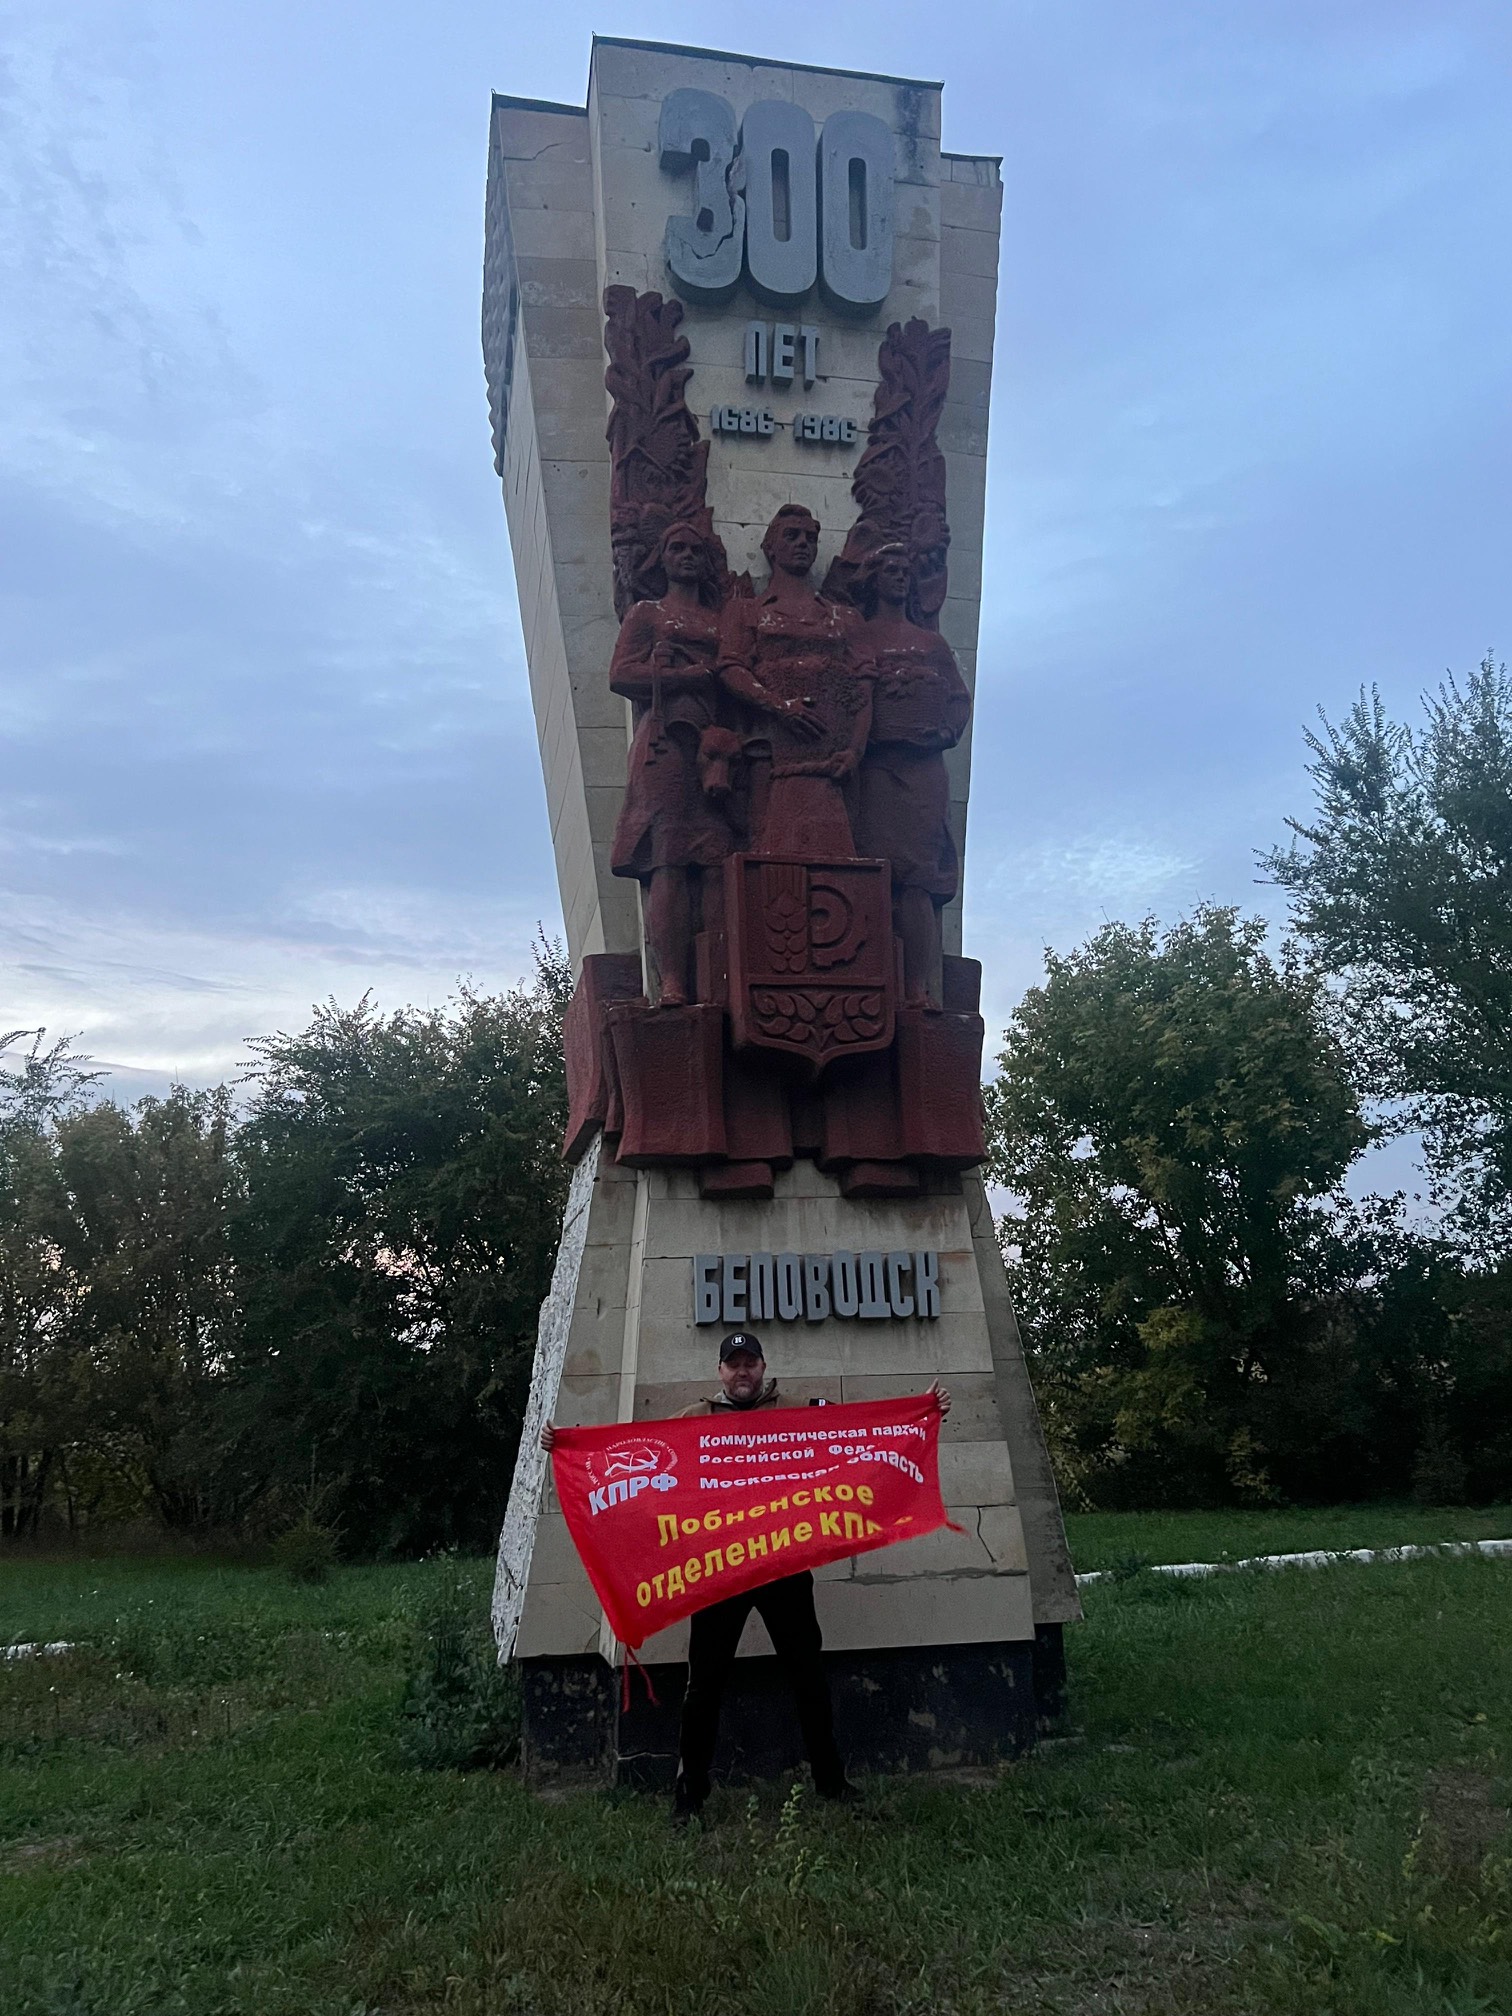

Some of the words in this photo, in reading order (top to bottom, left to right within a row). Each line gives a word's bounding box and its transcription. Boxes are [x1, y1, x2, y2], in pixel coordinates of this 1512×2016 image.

[658, 87, 896, 307] 300
[711, 404, 775, 436] 1686
[794, 412, 858, 444] 1986
[692, 1251, 941, 1326] БЕЛОВОДСК
[700, 1428, 868, 1449] Коммунистическая
[700, 1446, 815, 1464] Российской
[588, 1473, 678, 1516] КПРФ
[657, 1484, 874, 1547] Лобненское
[636, 1521, 813, 1607] отделение
